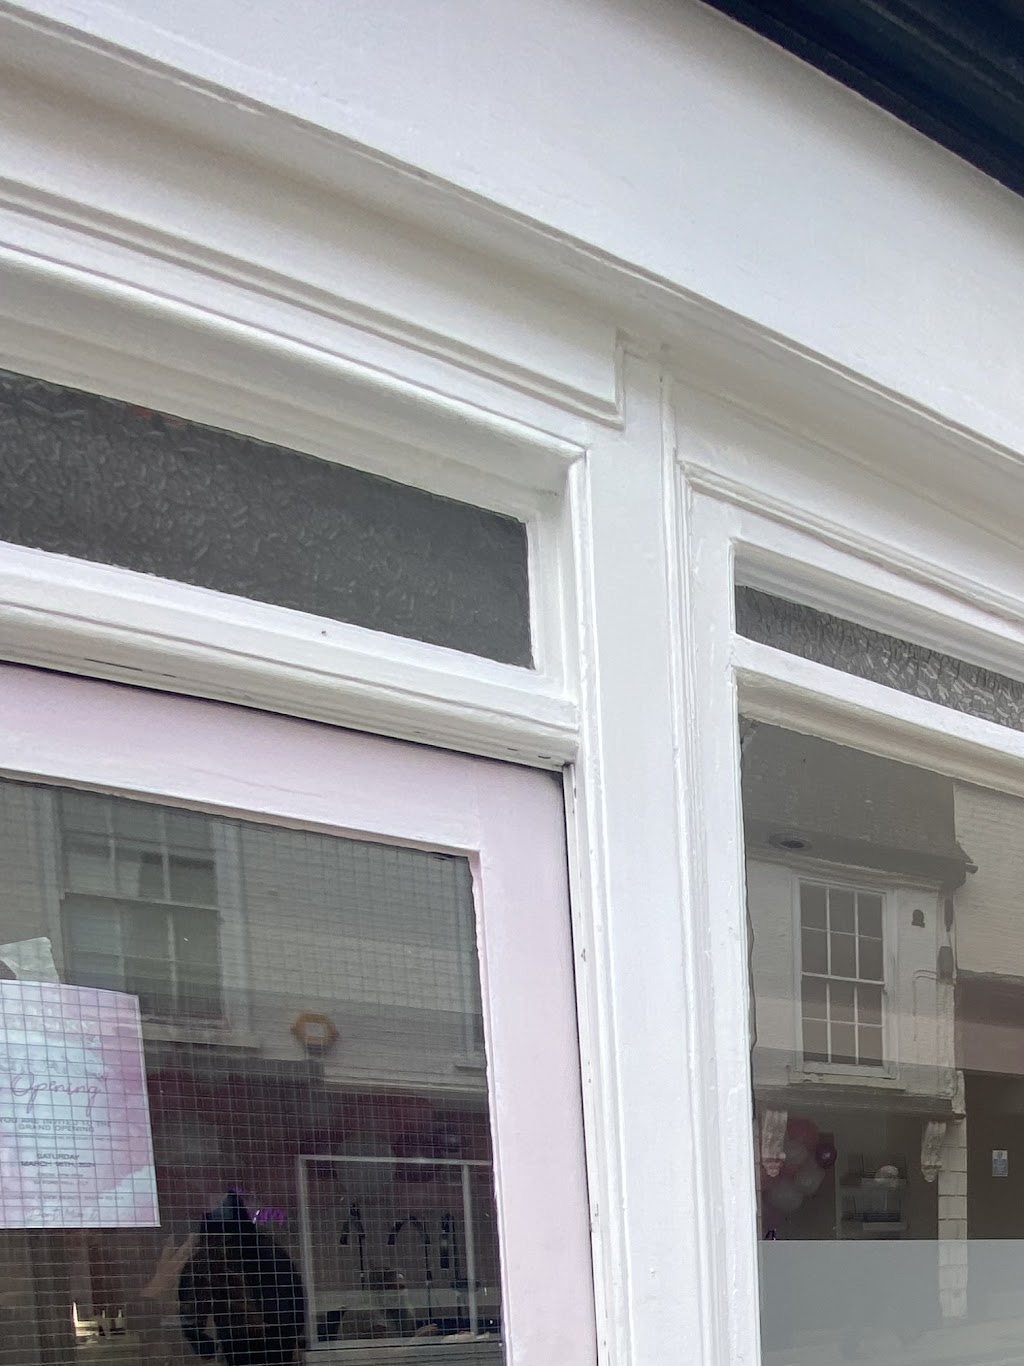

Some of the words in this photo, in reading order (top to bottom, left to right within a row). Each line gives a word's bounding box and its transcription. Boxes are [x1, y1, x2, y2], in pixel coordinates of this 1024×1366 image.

[11, 1072, 101, 1115] Opening
[55, 1125, 95, 1133] OPENING
[36, 1153, 80, 1161] SATURDAY
